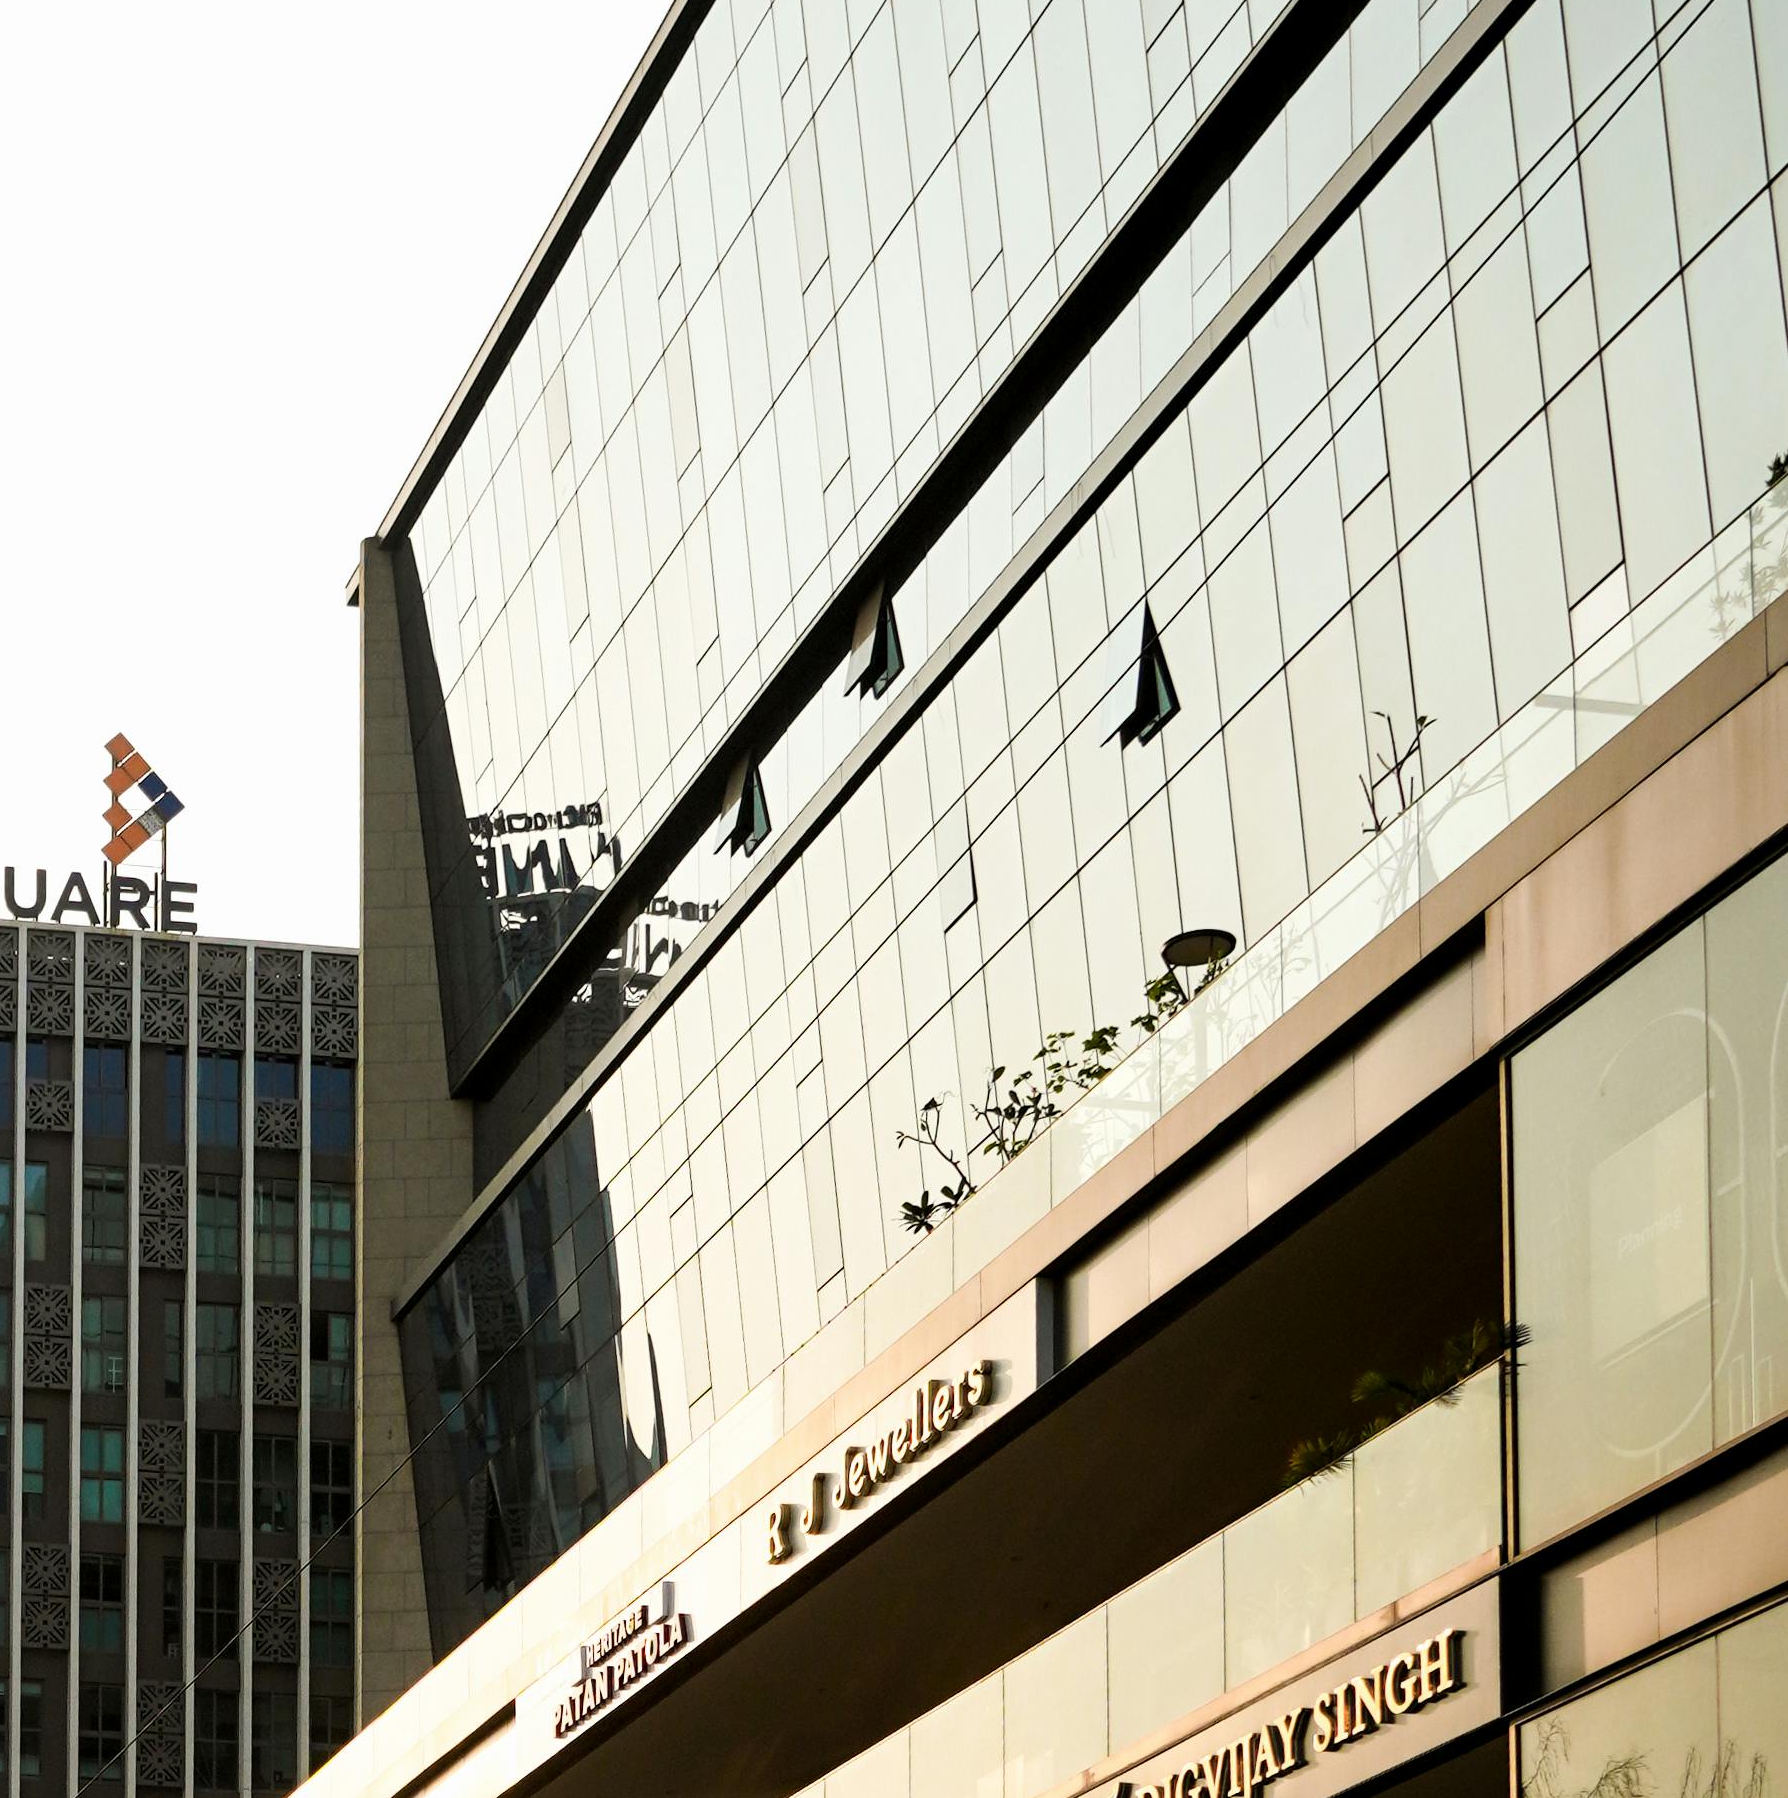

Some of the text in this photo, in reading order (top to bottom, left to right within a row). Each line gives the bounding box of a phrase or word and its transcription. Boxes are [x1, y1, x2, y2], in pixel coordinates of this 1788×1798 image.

[554, 1613, 688, 1738] PATAN PATOLA
[585, 1605, 649, 1667] HERITAGE
[1313, 1628, 1465, 1752] SINGH
